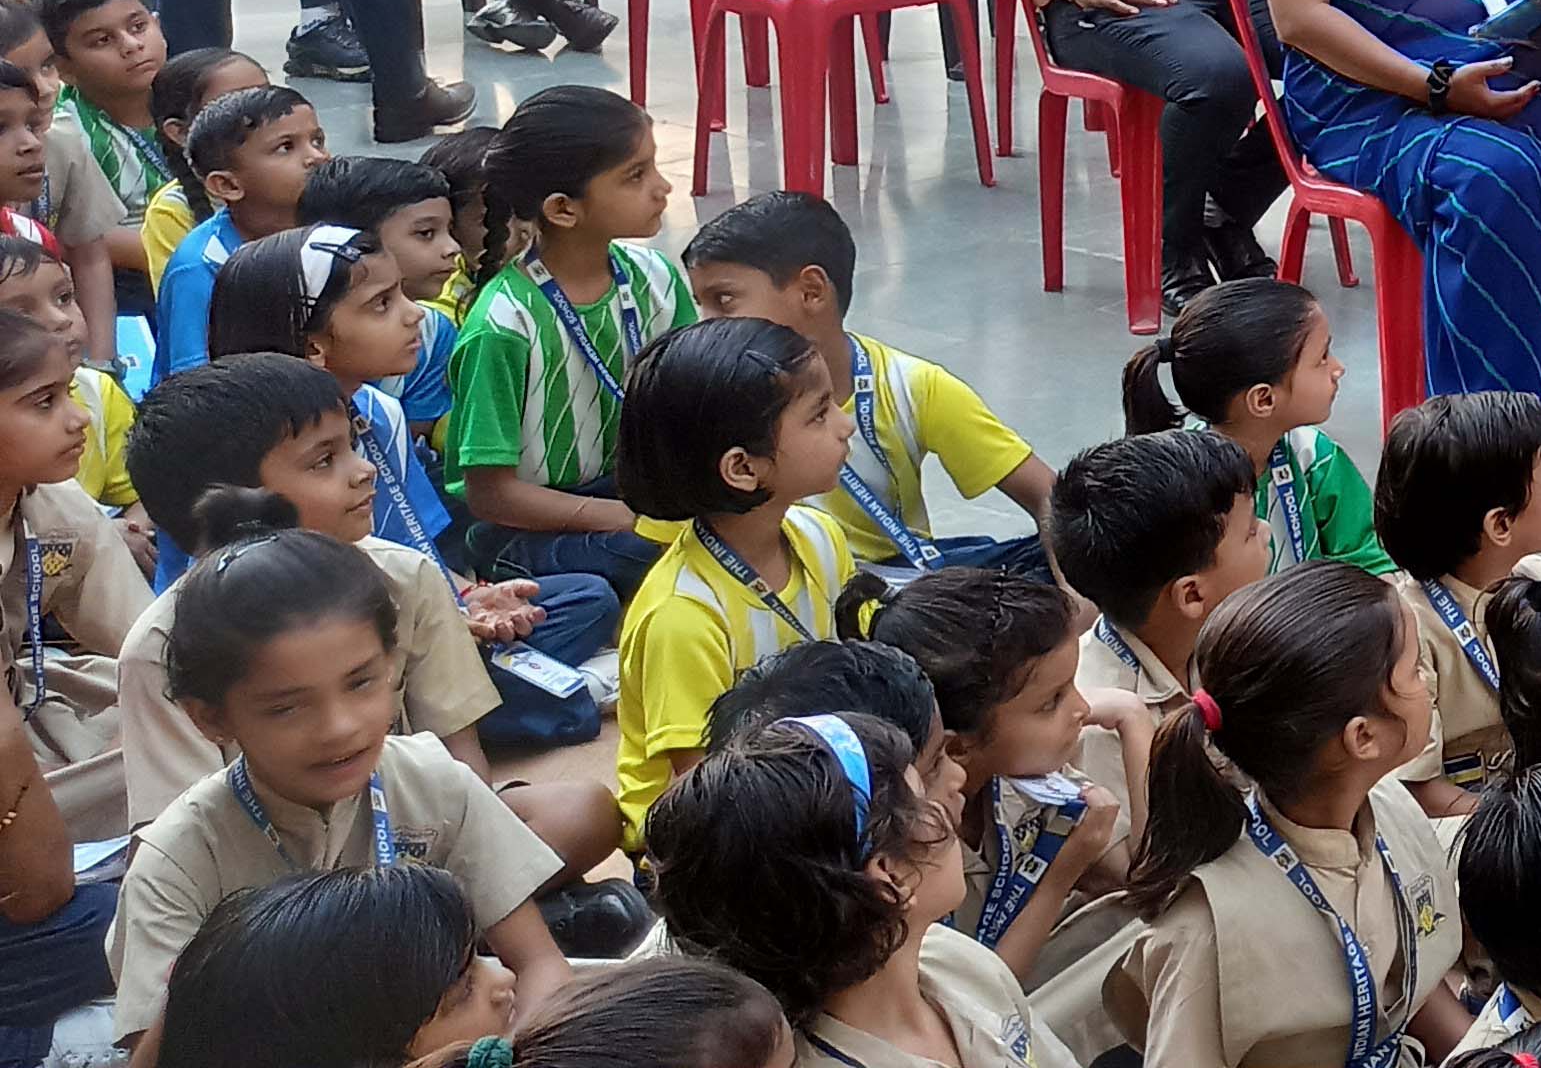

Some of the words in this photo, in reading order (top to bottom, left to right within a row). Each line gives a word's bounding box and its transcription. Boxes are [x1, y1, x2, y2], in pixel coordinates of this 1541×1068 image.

[366, 435, 395, 485] SCHOOL
[840, 465, 873, 503] HERITA
[389, 483, 427, 545] HERITAGE
[868, 500, 902, 536] INDIAN
[1283, 486, 1302, 539] SCHOOL
[898, 533, 919, 557] THE
[30, 544, 41, 601] SCHOOL
[721, 554, 749, 579] THE
[1437, 594, 1459, 623] THE
[1472, 644, 1500, 689] CHOOL
[1004, 883, 1026, 914] THE
[1344, 931, 1372, 1017] HERITAGE
